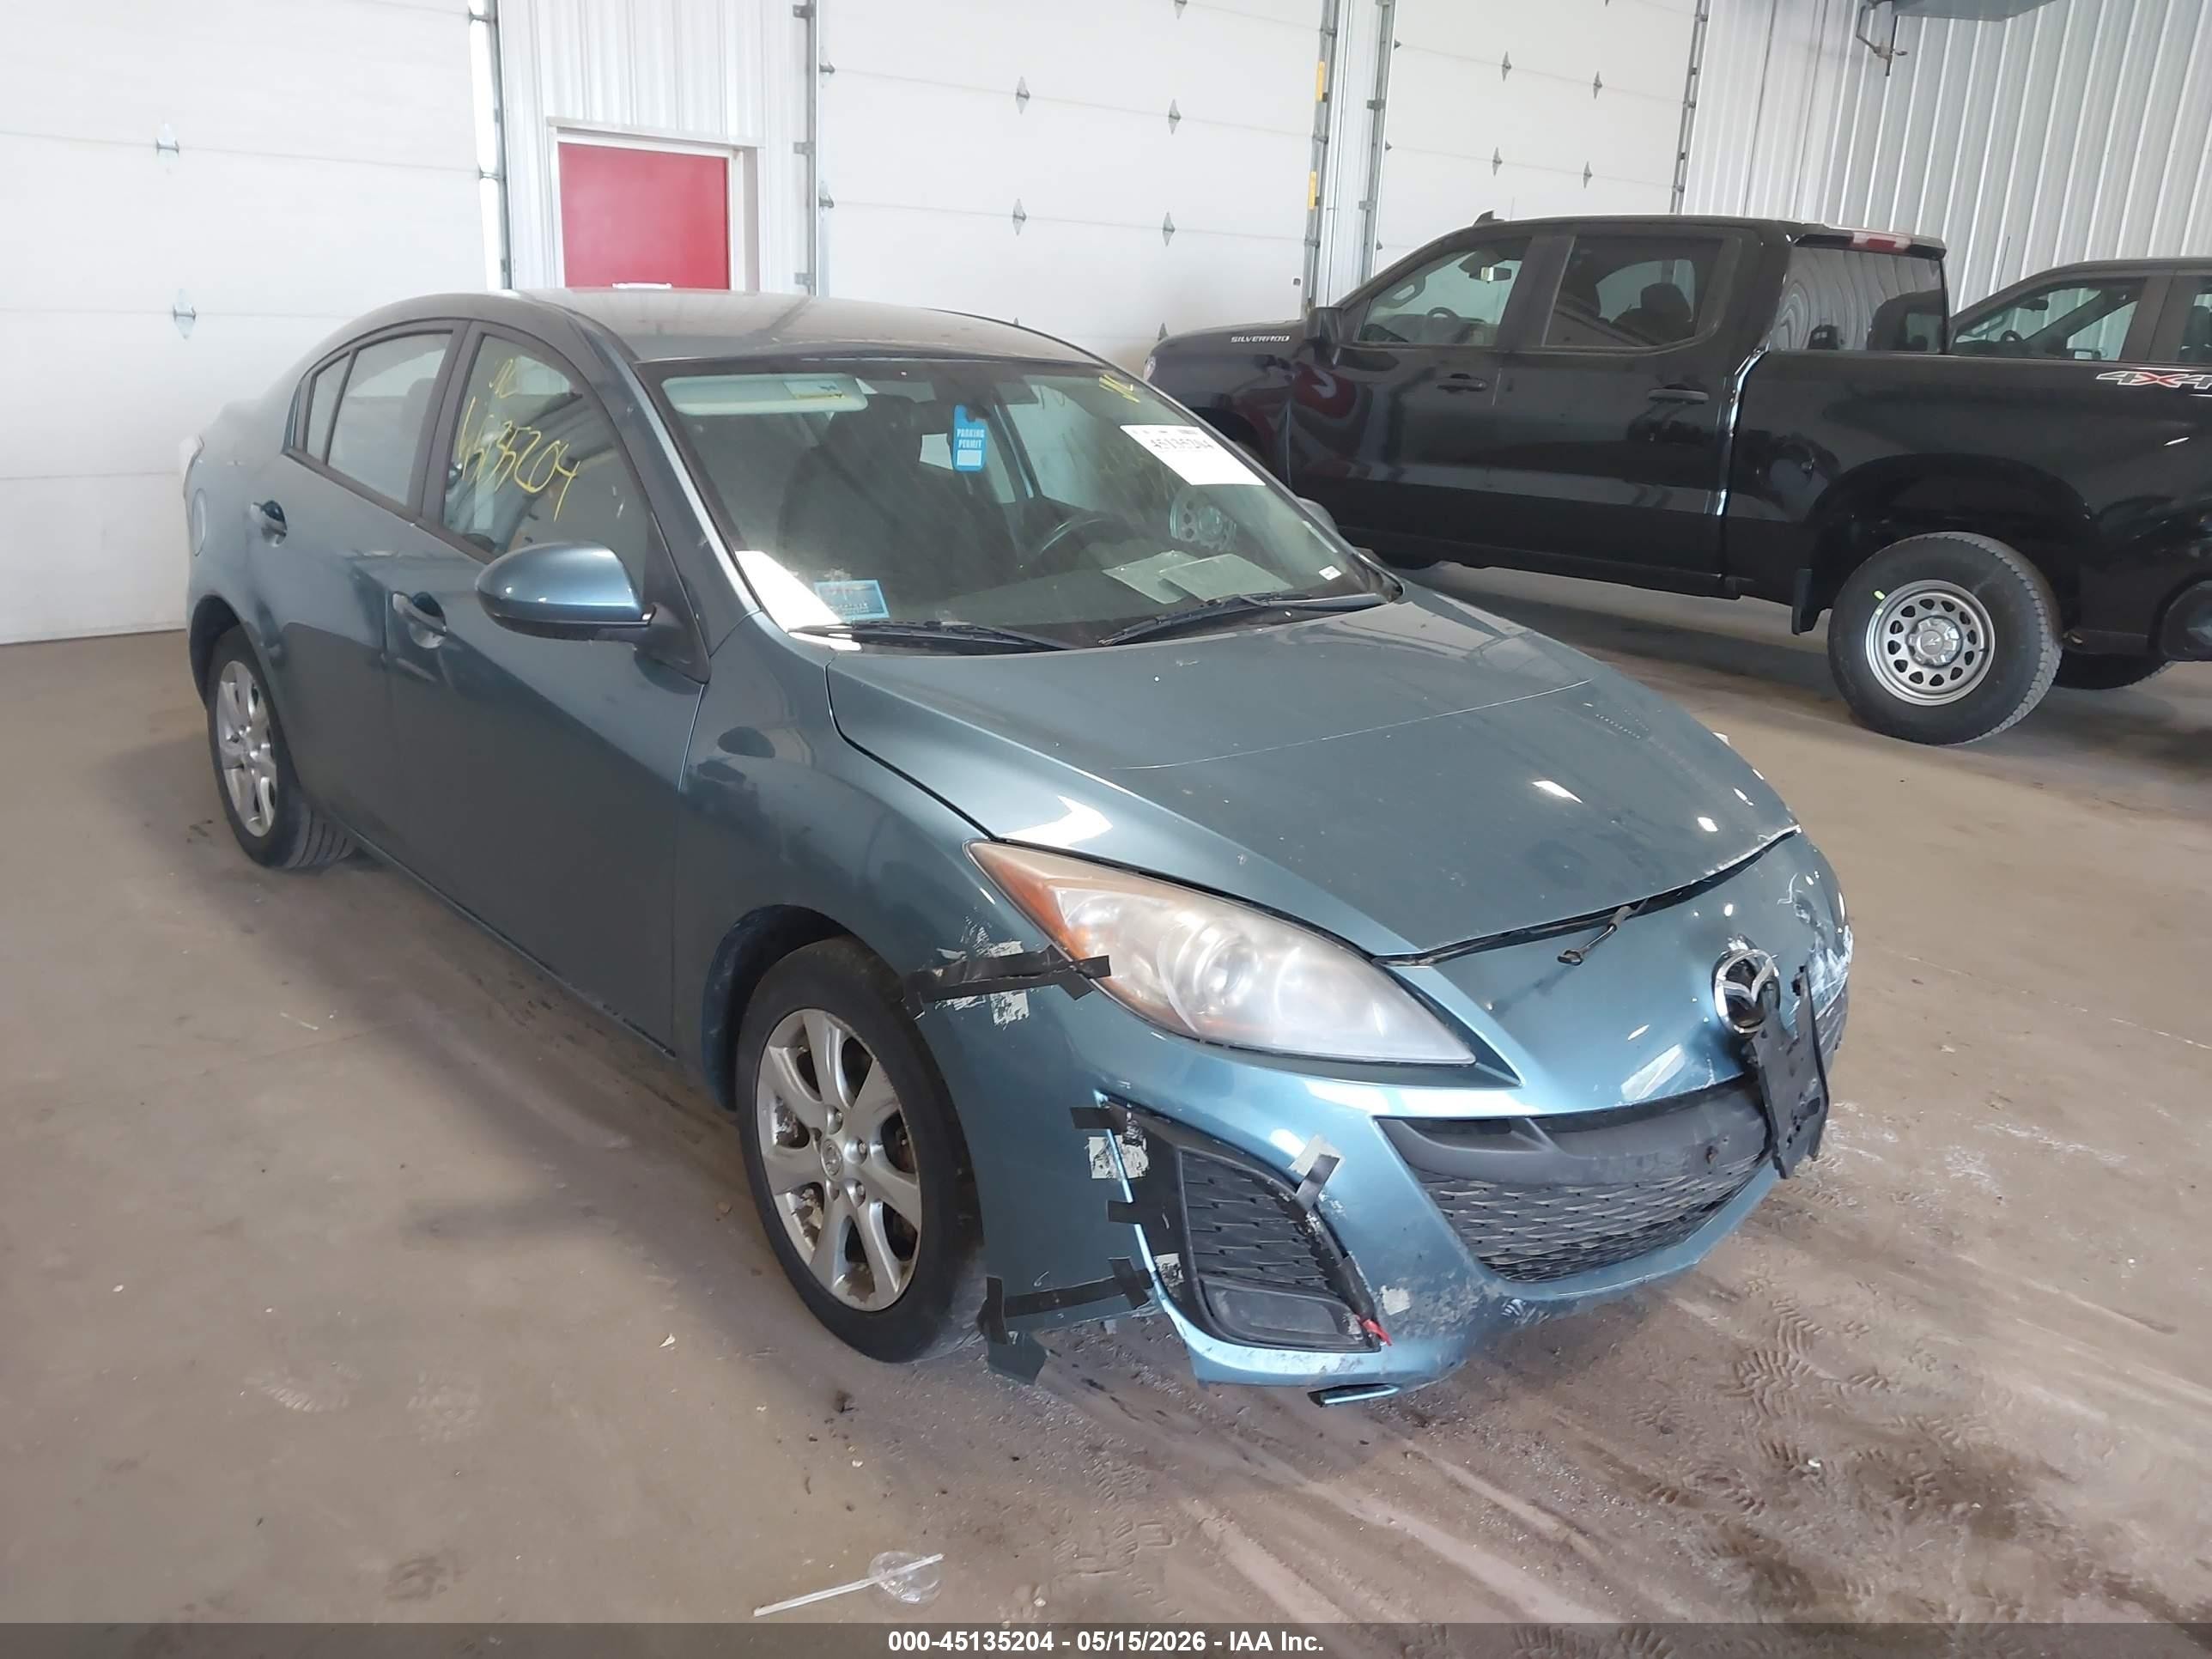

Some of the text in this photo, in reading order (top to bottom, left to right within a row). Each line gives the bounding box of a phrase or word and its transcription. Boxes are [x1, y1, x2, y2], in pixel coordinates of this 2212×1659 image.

[1231, 335, 1291, 343] SILVERADO
[957, 428, 985, 438] PARKING
[958, 439, 982, 449] PERMIT
